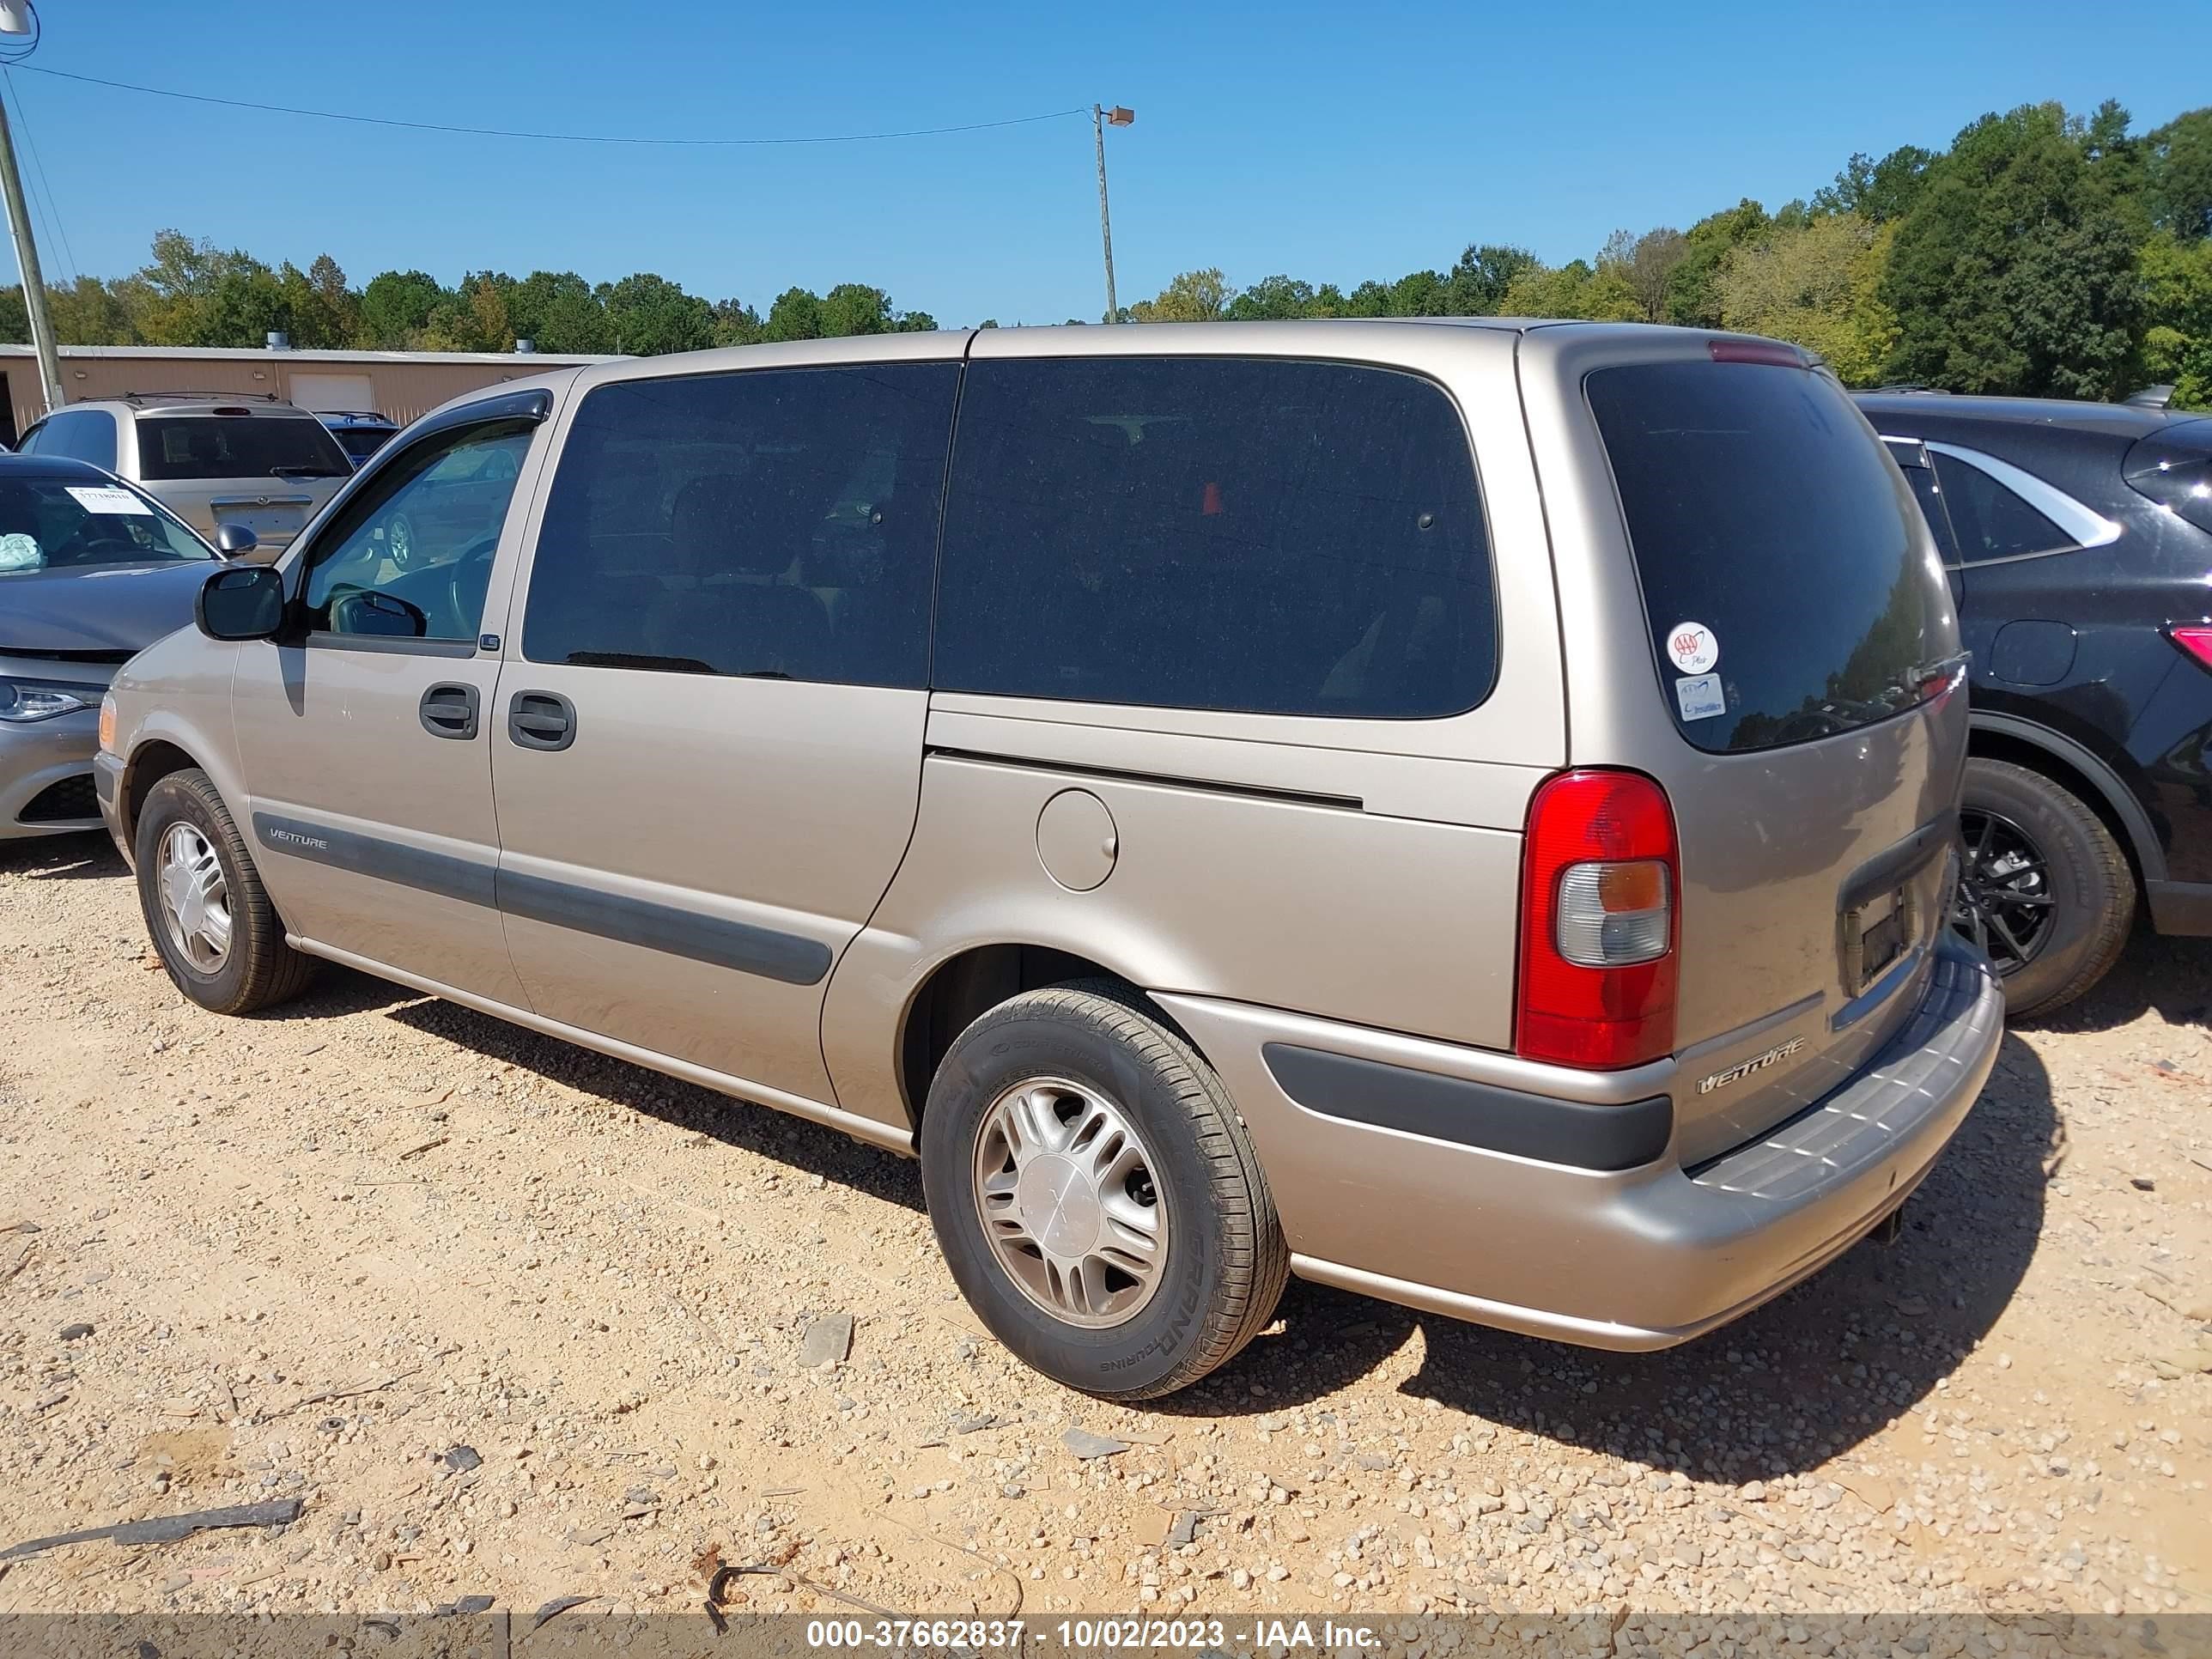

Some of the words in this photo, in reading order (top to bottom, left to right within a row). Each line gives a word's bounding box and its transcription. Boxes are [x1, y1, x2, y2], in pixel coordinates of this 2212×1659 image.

[481, 635, 498, 649] LS
[1675, 635, 1698, 654] AAA
[270, 827, 328, 849] VENTURE
[1697, 1035, 1805, 1094] VENTURE
[1100, 1334, 1160, 1372] TOURING
